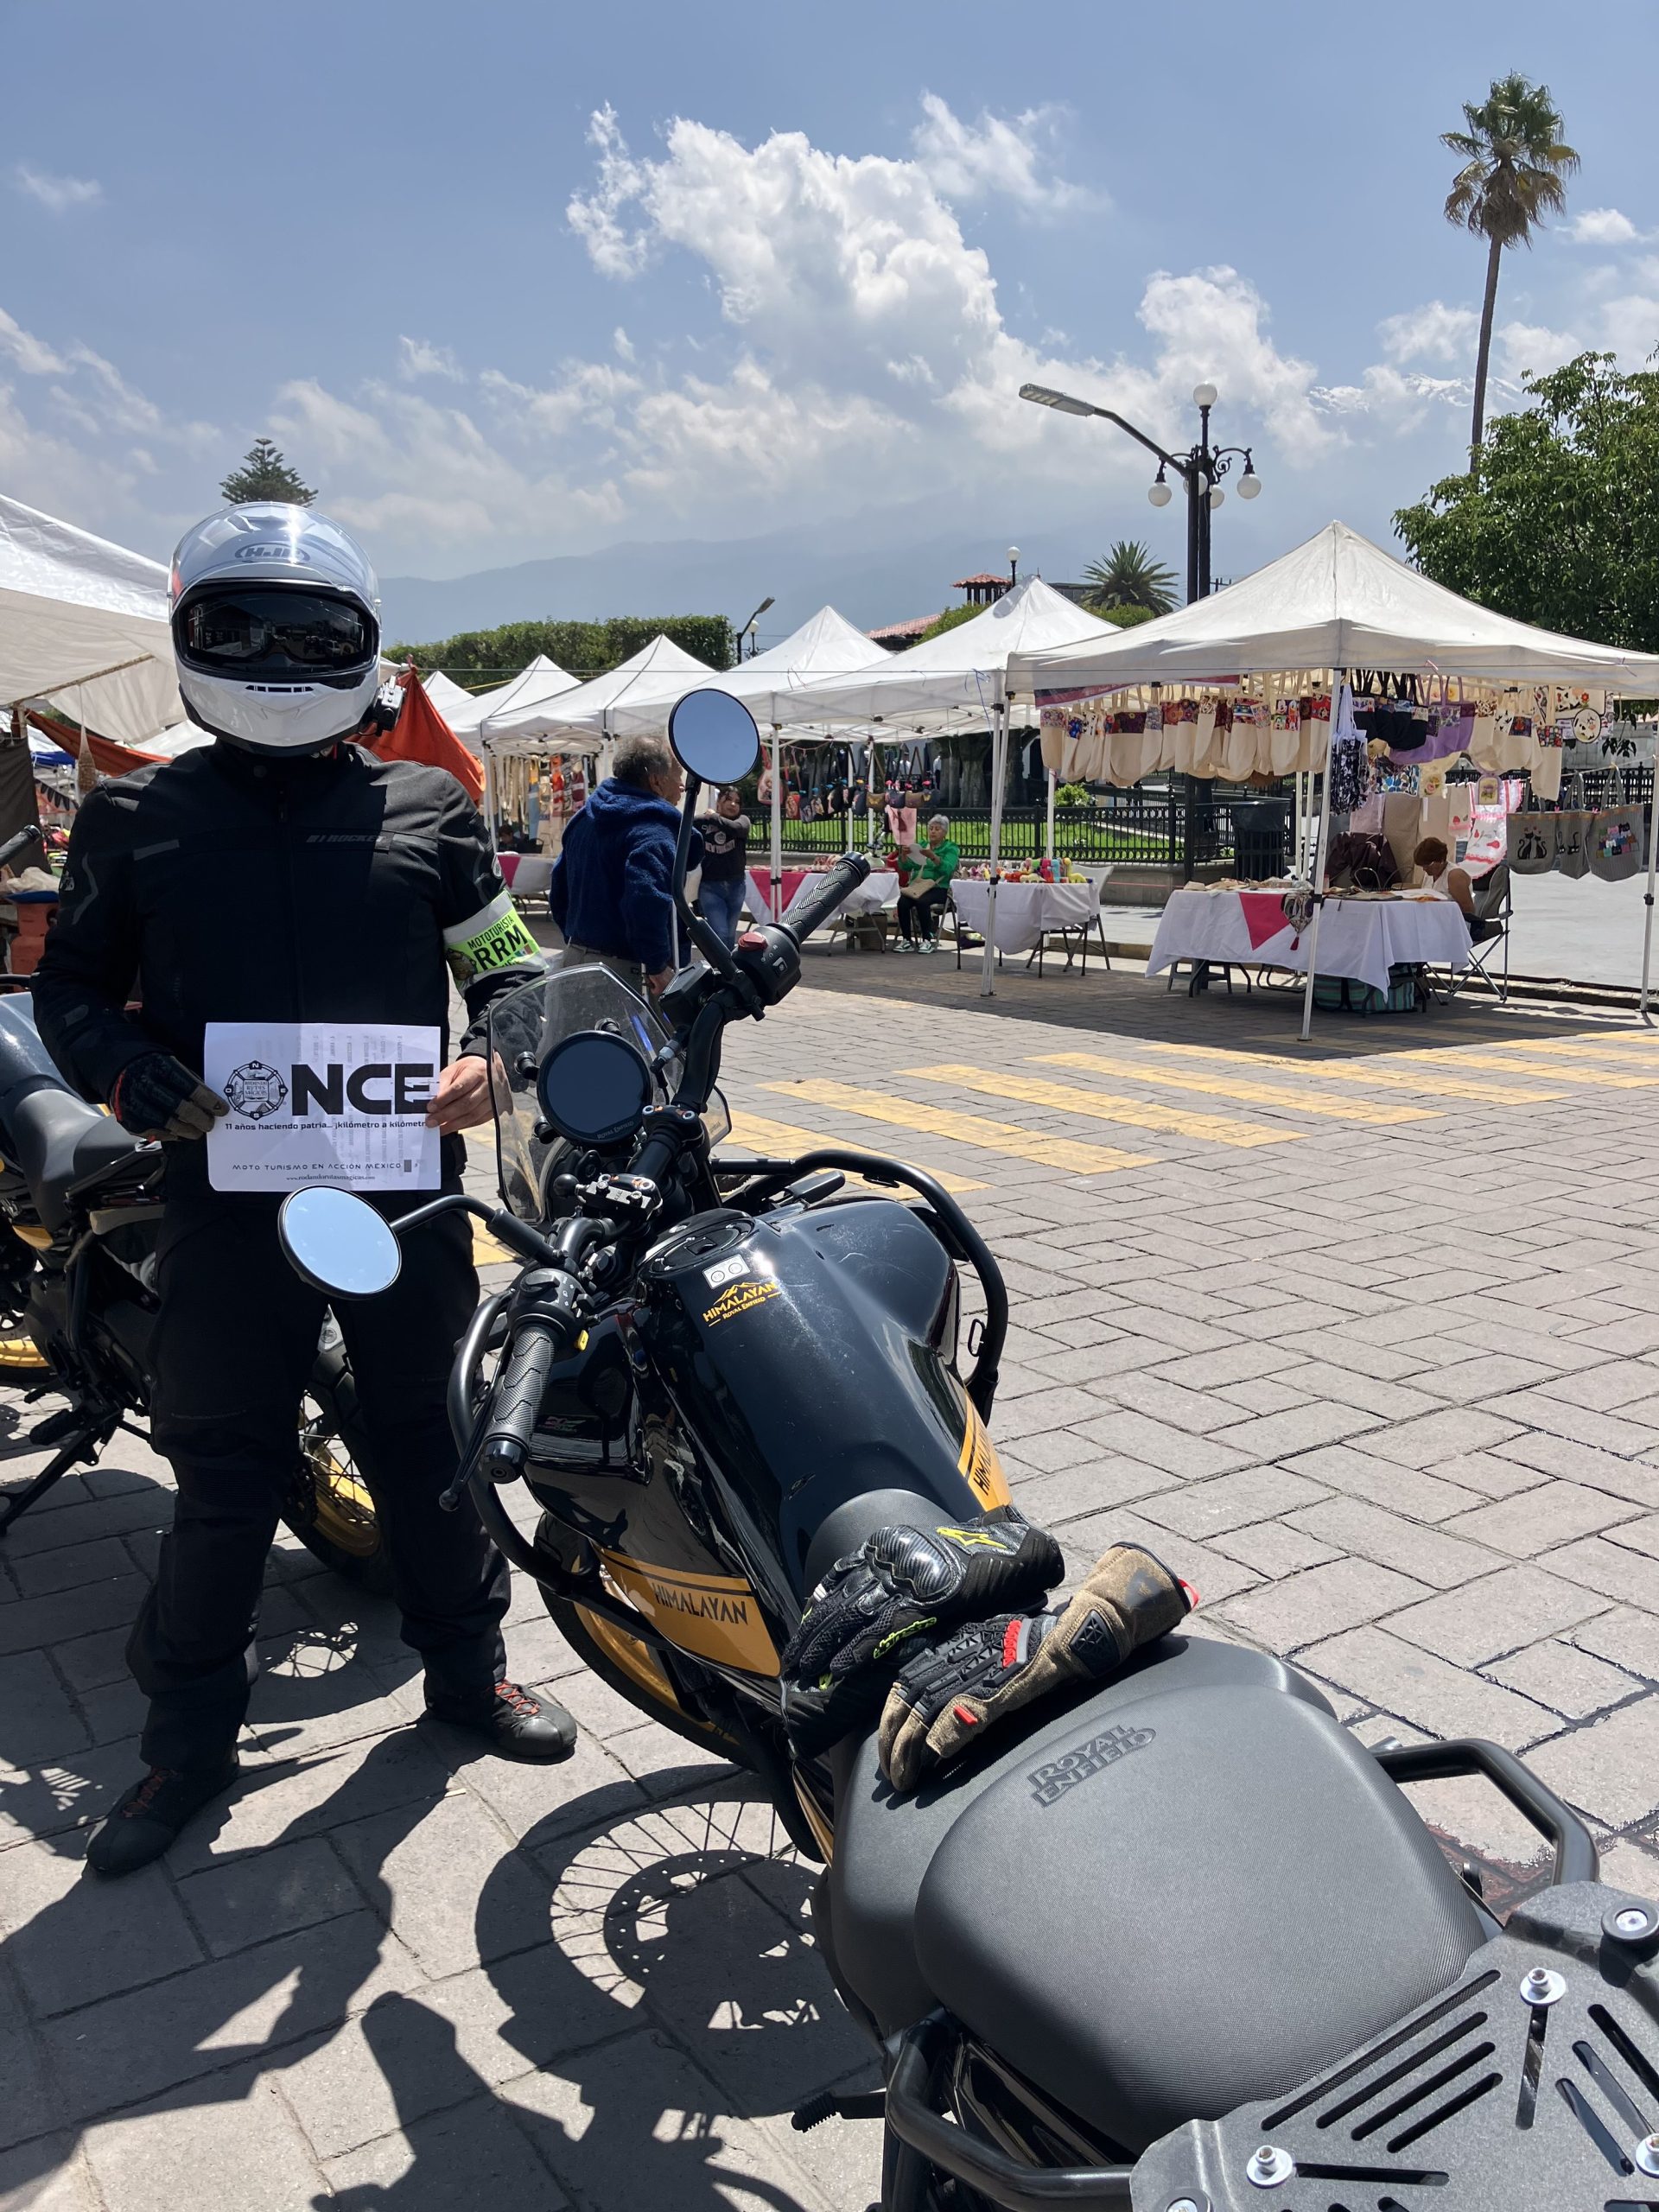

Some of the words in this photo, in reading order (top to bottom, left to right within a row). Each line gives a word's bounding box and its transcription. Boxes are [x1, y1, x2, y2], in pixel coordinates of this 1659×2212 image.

[467, 915, 514, 950] MOTOTURISTA
[473, 925, 529, 970] RRM
[702, 1281, 777, 1323] HIMALAYAN
[722, 1306, 743, 1319] ROYAL
[741, 1296, 766, 1310] ENFIELD
[652, 1582, 748, 1626] HIMALAYAN
[1027, 1725, 1136, 1791] ROYAL
[1033, 1728, 1156, 1807] ENFIELD
